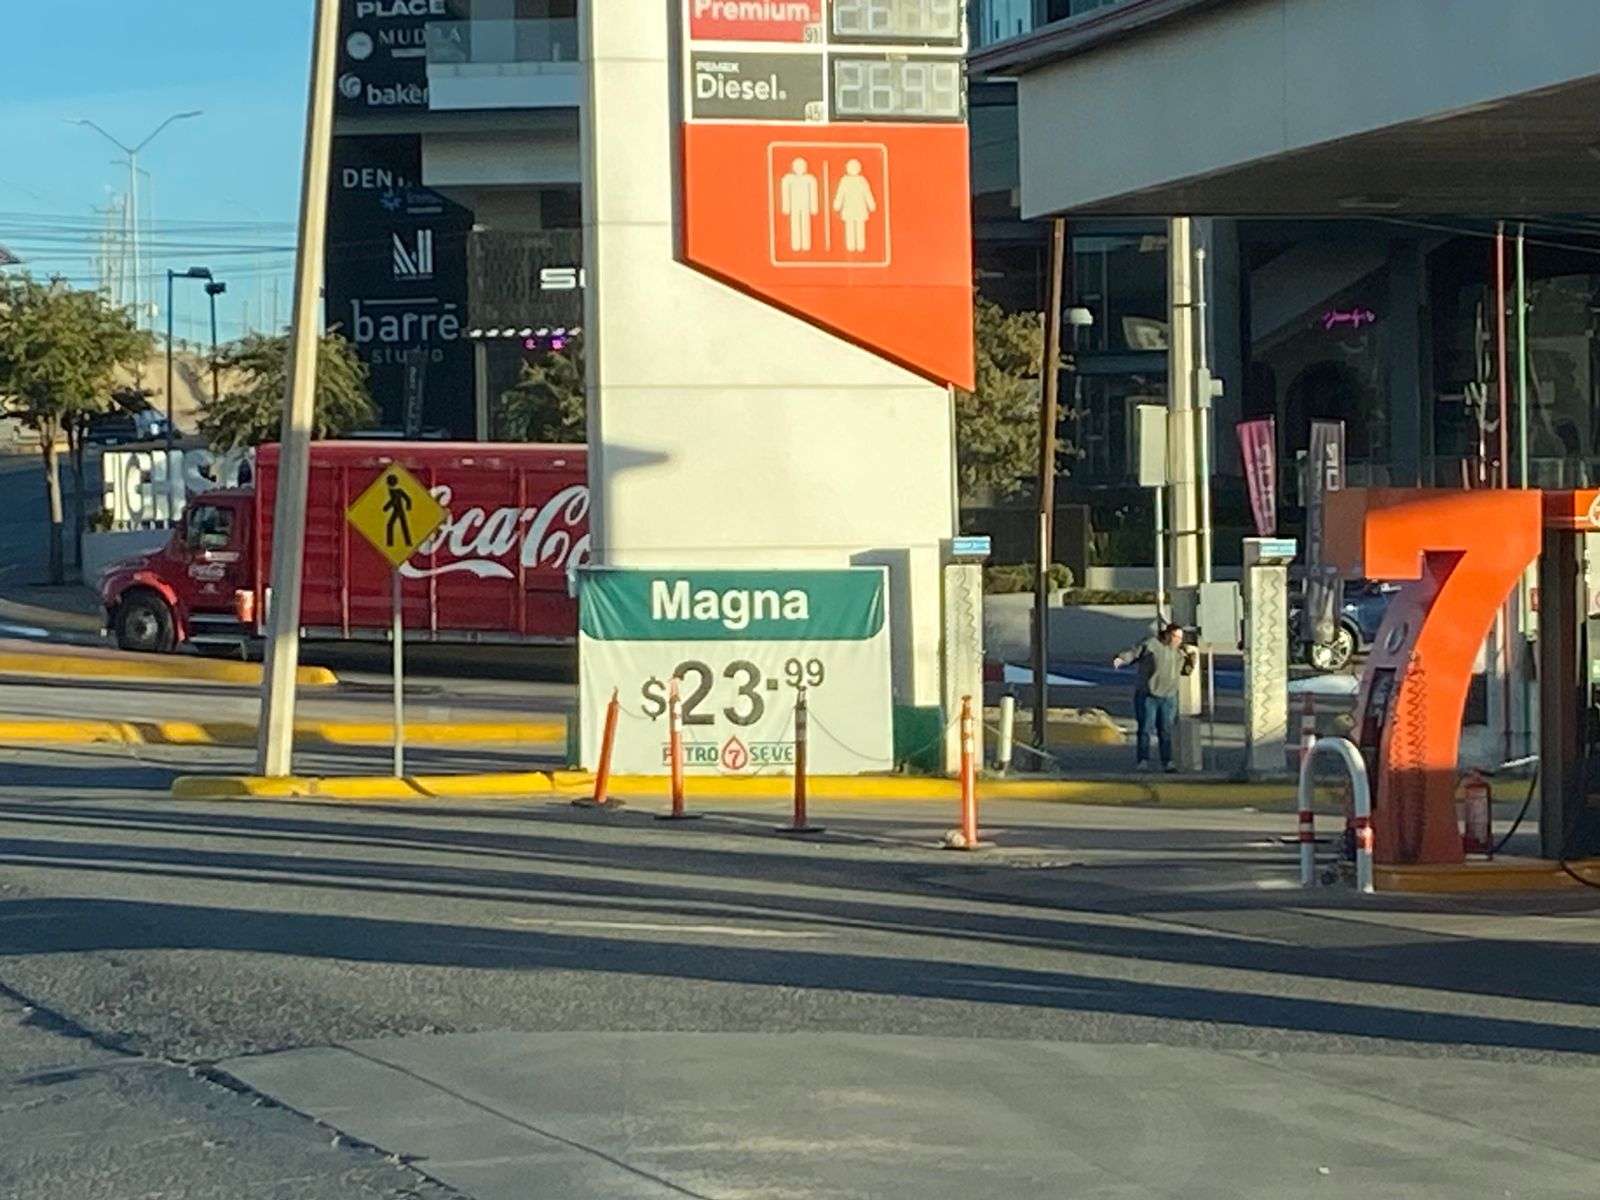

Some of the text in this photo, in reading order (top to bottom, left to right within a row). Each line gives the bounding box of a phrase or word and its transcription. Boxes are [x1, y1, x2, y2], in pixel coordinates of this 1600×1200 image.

[357, 0, 446, 18] PLACE
[378, 27, 461, 46] MUDA
[372, 347, 444, 365] stuo
[651, 579, 810, 630] Magna
[663, 746, 719, 762] PTRO
[749, 745, 796, 762] SEVE
